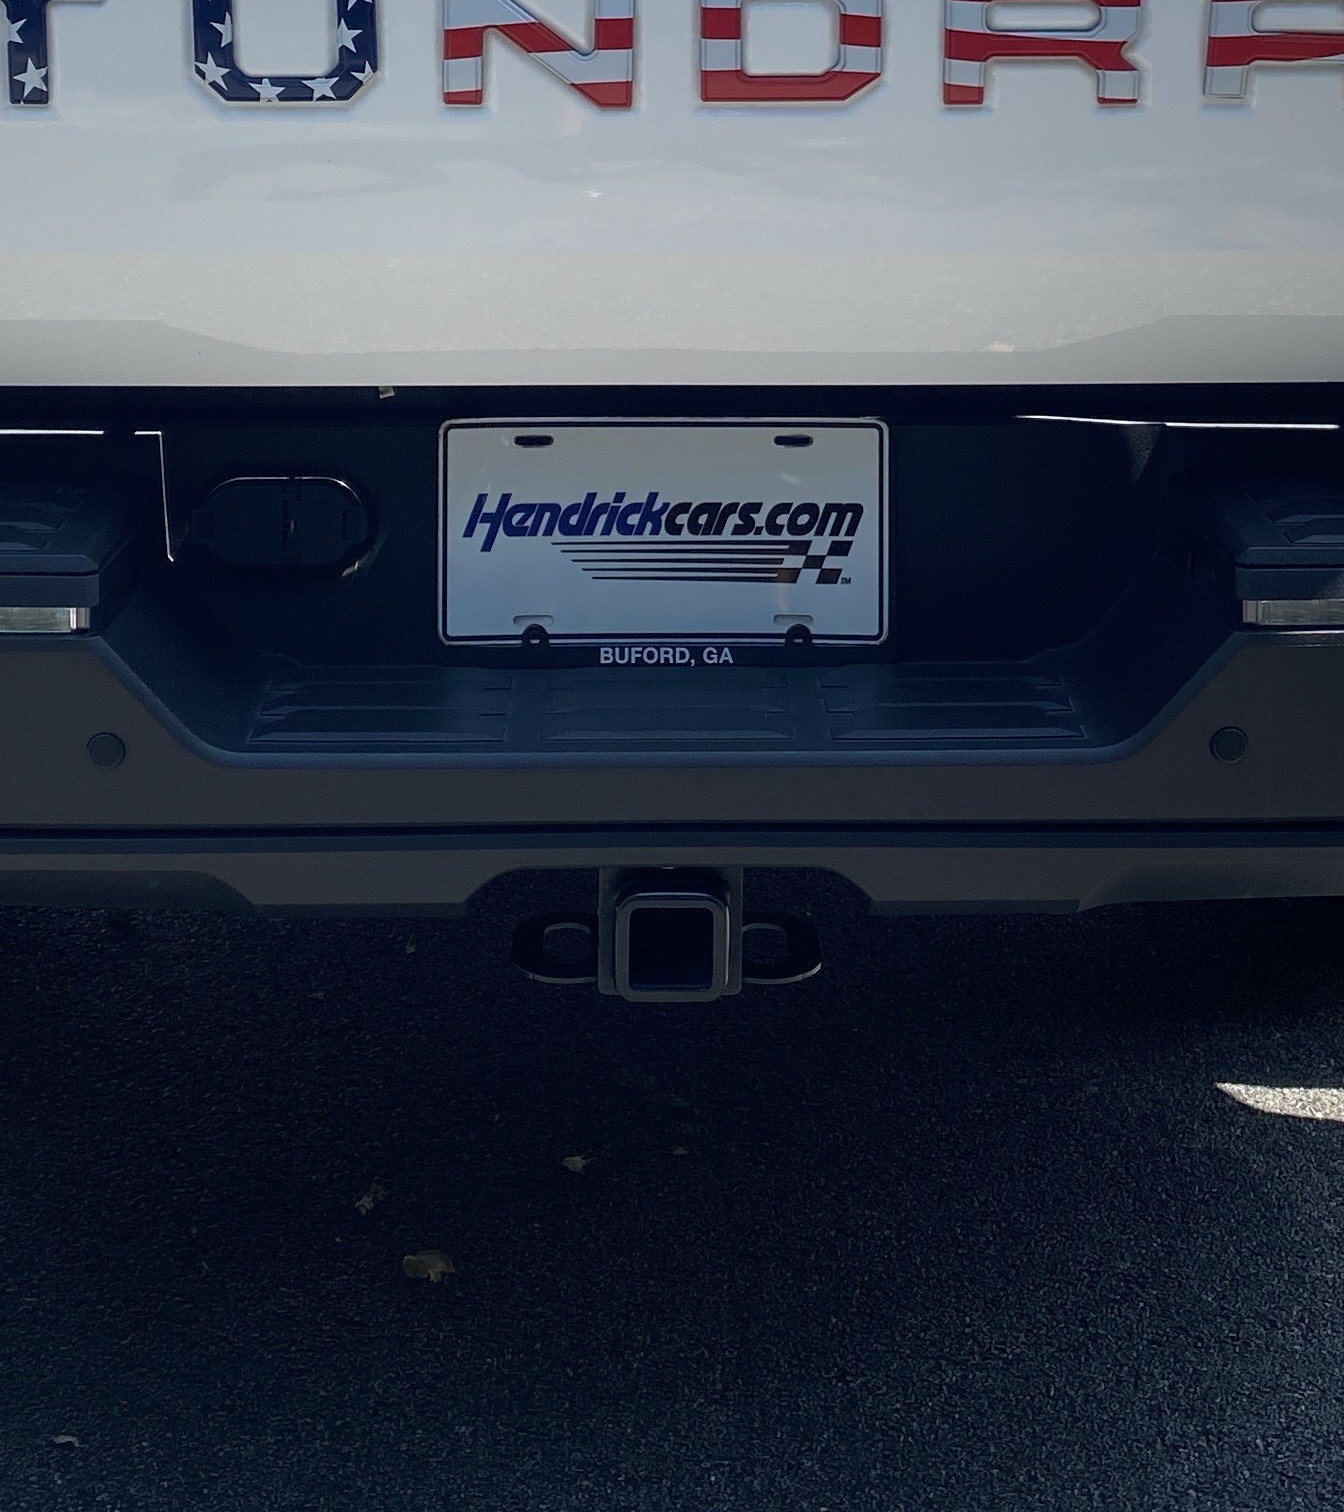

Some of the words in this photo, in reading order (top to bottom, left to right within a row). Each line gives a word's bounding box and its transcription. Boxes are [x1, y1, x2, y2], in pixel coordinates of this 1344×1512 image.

[462, 491, 864, 552] Hendrickcars.com
[599, 646, 696, 667] BUFORD,
[702, 647, 734, 665] GA
